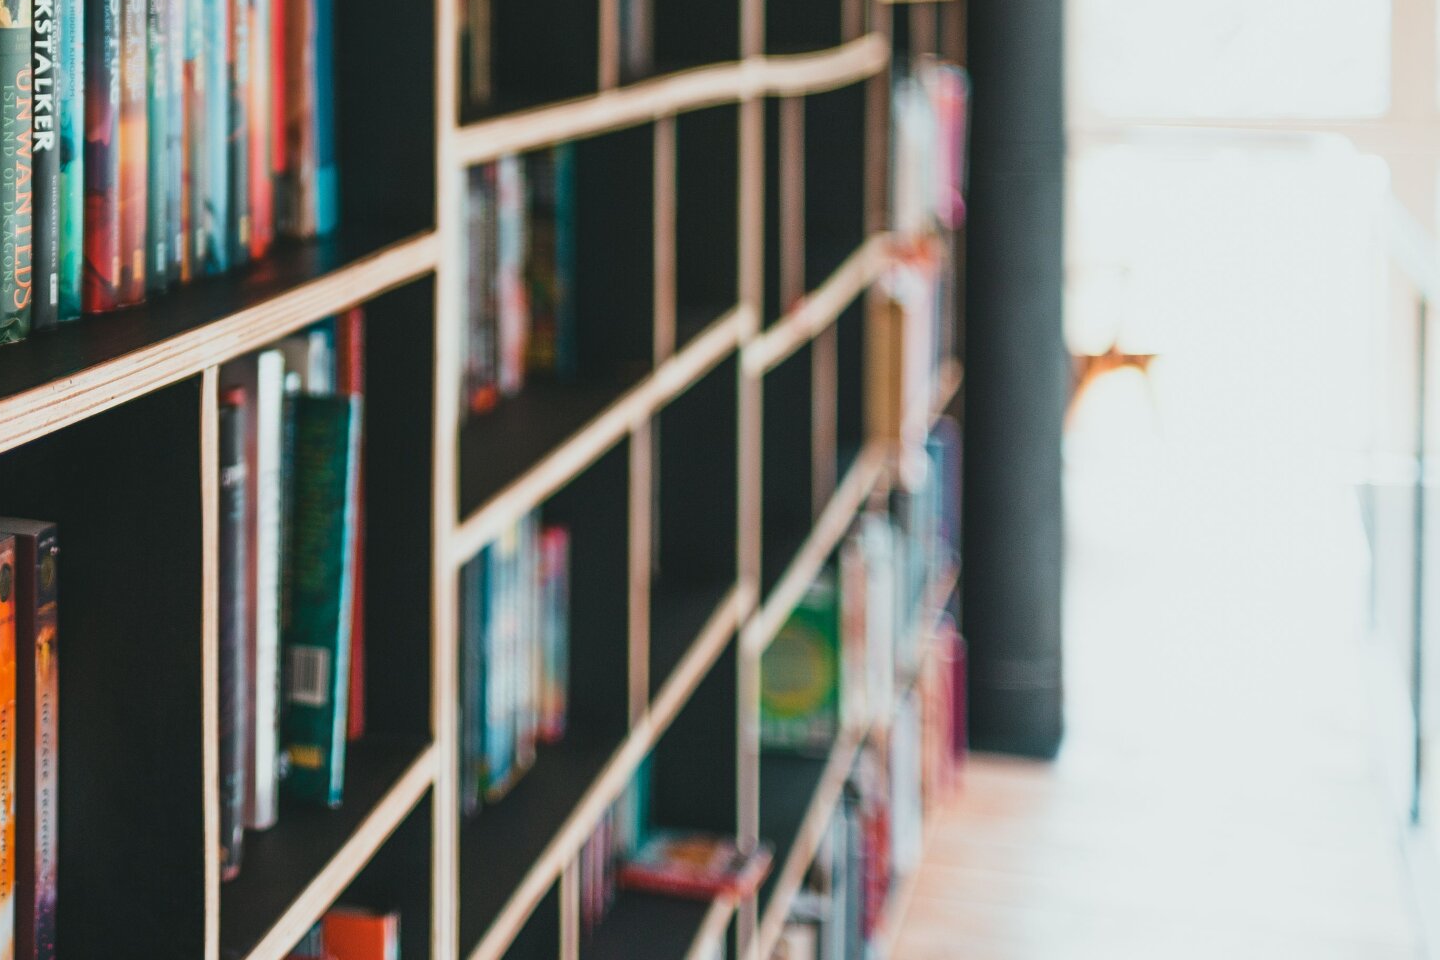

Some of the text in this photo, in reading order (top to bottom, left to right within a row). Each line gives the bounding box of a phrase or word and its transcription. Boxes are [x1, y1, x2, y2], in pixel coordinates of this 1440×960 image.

[2, 85, 15, 293] ISLAND OF DRAGONS
[14, 69, 32, 309] UNWANTEDS
